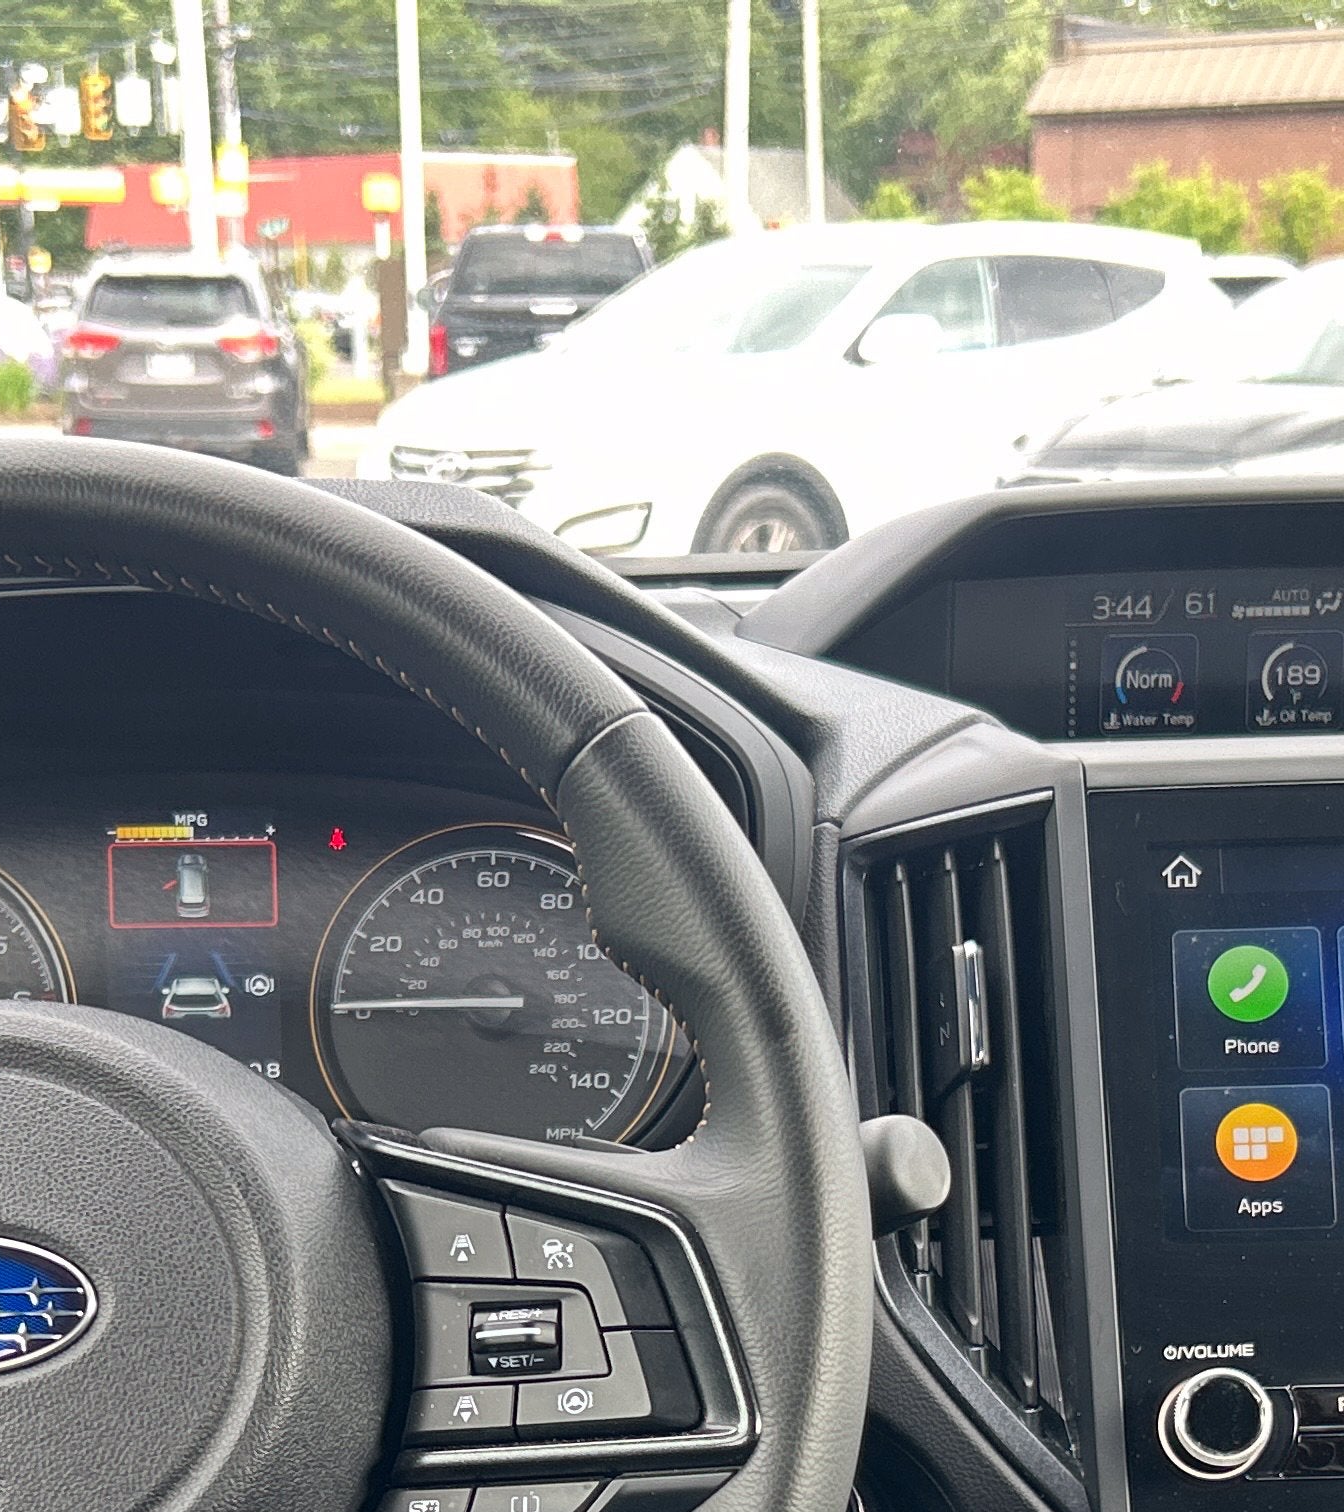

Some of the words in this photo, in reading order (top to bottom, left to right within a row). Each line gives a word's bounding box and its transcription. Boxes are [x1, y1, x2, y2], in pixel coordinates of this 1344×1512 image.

[1273, 589, 1309, 602] AUTO
[1092, 595, 1153, 620] 3:44
[1185, 592, 1216, 615] 61
[1126, 670, 1173, 689] Norm
[1276, 664, 1321, 686] 189
[1122, 713, 1157, 728] Water
[1163, 712, 1195, 728] Temp
[1279, 710, 1297, 723] Oil
[1301, 709, 1333, 724] Temp
[174, 814, 208, 826] MPG
[477, 871, 510, 888] 60
[410, 888, 444, 905] 40
[540, 893, 573, 910] 80
[462, 928, 482, 939] 80
[485, 926, 510, 938] 100
[512, 933, 536, 944] 120
[369, 937, 403, 953] 20
[438, 939, 458, 950] 60
[478, 939, 503, 949] km/h
[533, 948, 557, 959] 140
[419, 956, 441, 968] 40
[545, 969, 570, 981] 160
[407, 980, 427, 992] 20
[553, 993, 577, 1005] 180
[592, 1009, 632, 1025] 120
[551, 1018, 579, 1030] 200
[543, 1042, 571, 1054] 220
[1224, 1037, 1280, 1054] Phone
[529, 1064, 557, 1075] 240
[570, 1073, 610, 1089] 140
[546, 1127, 584, 1140] MPH
[1238, 1198, 1283, 1217] Apps
